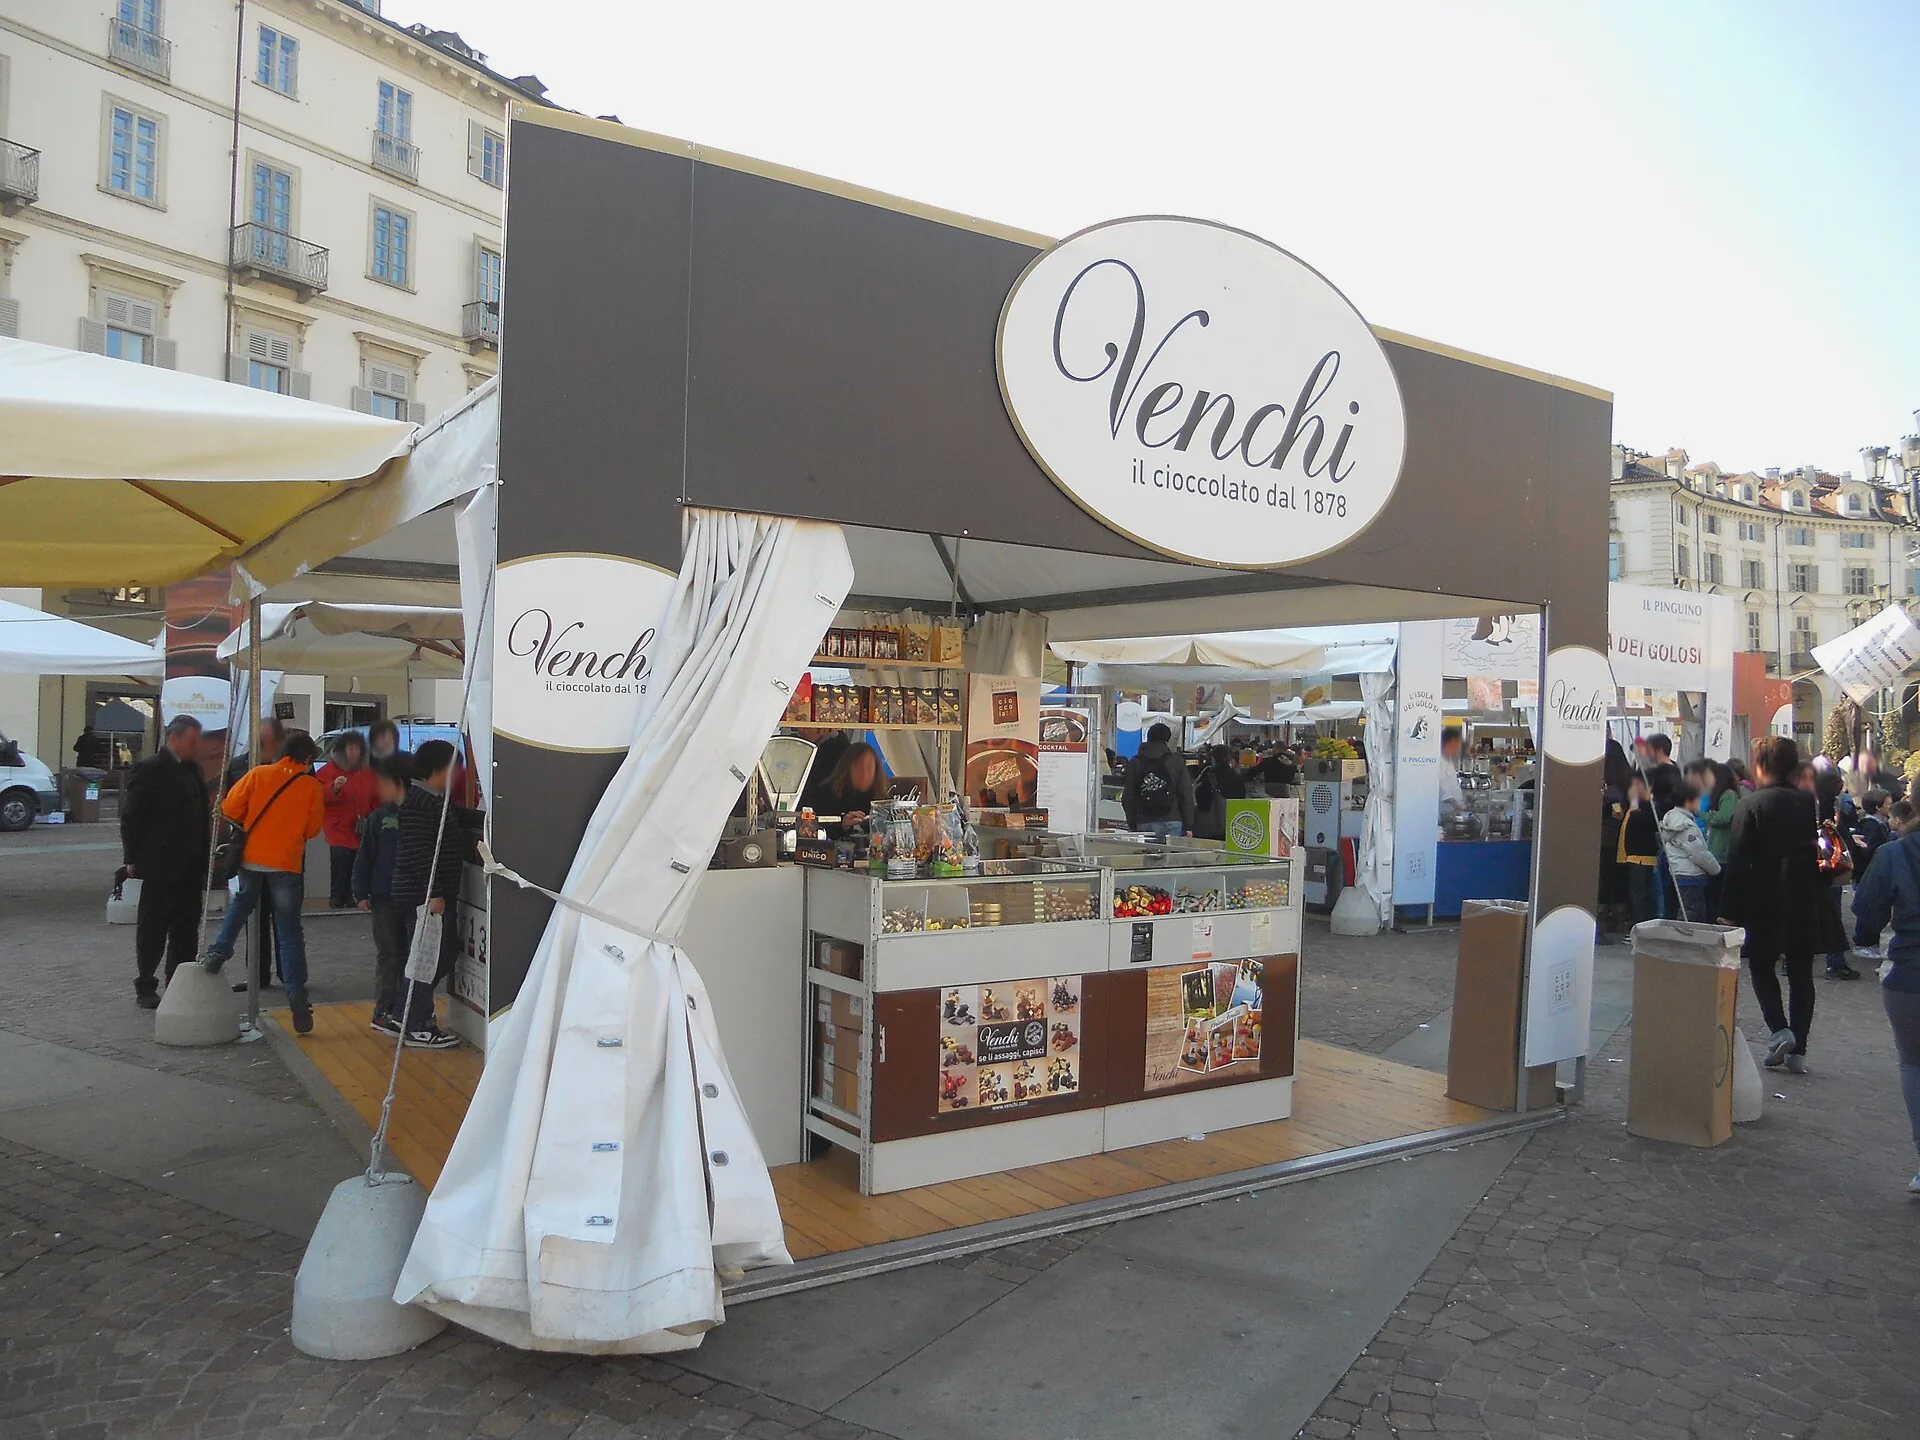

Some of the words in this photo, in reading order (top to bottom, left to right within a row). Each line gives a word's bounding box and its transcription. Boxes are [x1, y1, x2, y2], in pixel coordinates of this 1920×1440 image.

[1053, 258, 1360, 483] Venchi
[1132, 458, 1146, 485] il
[1153, 464, 1260, 503] cioccolato
[1266, 484, 1296, 510] dal
[1303, 489, 1347, 518] 1878
[1643, 599, 1651, 611] IL
[1654, 600, 1702, 617] PINGUINO
[508, 608, 655, 681] Vench
[1618, 636, 1643, 658] DEI
[1648, 643, 1702, 665] GOLOSI
[545, 680, 553, 692] il
[556, 682, 611, 694] cioccolato
[614, 683, 631, 694] dal
[634, 684, 647, 695] 18
[1550, 679, 1603, 723] Venchi
[802, 850, 827, 860] UNICO
[979, 1026, 1020, 1047] Venchi
[978, 1054, 987, 1062] se
[1022, 1046, 1045, 1057] capisci
